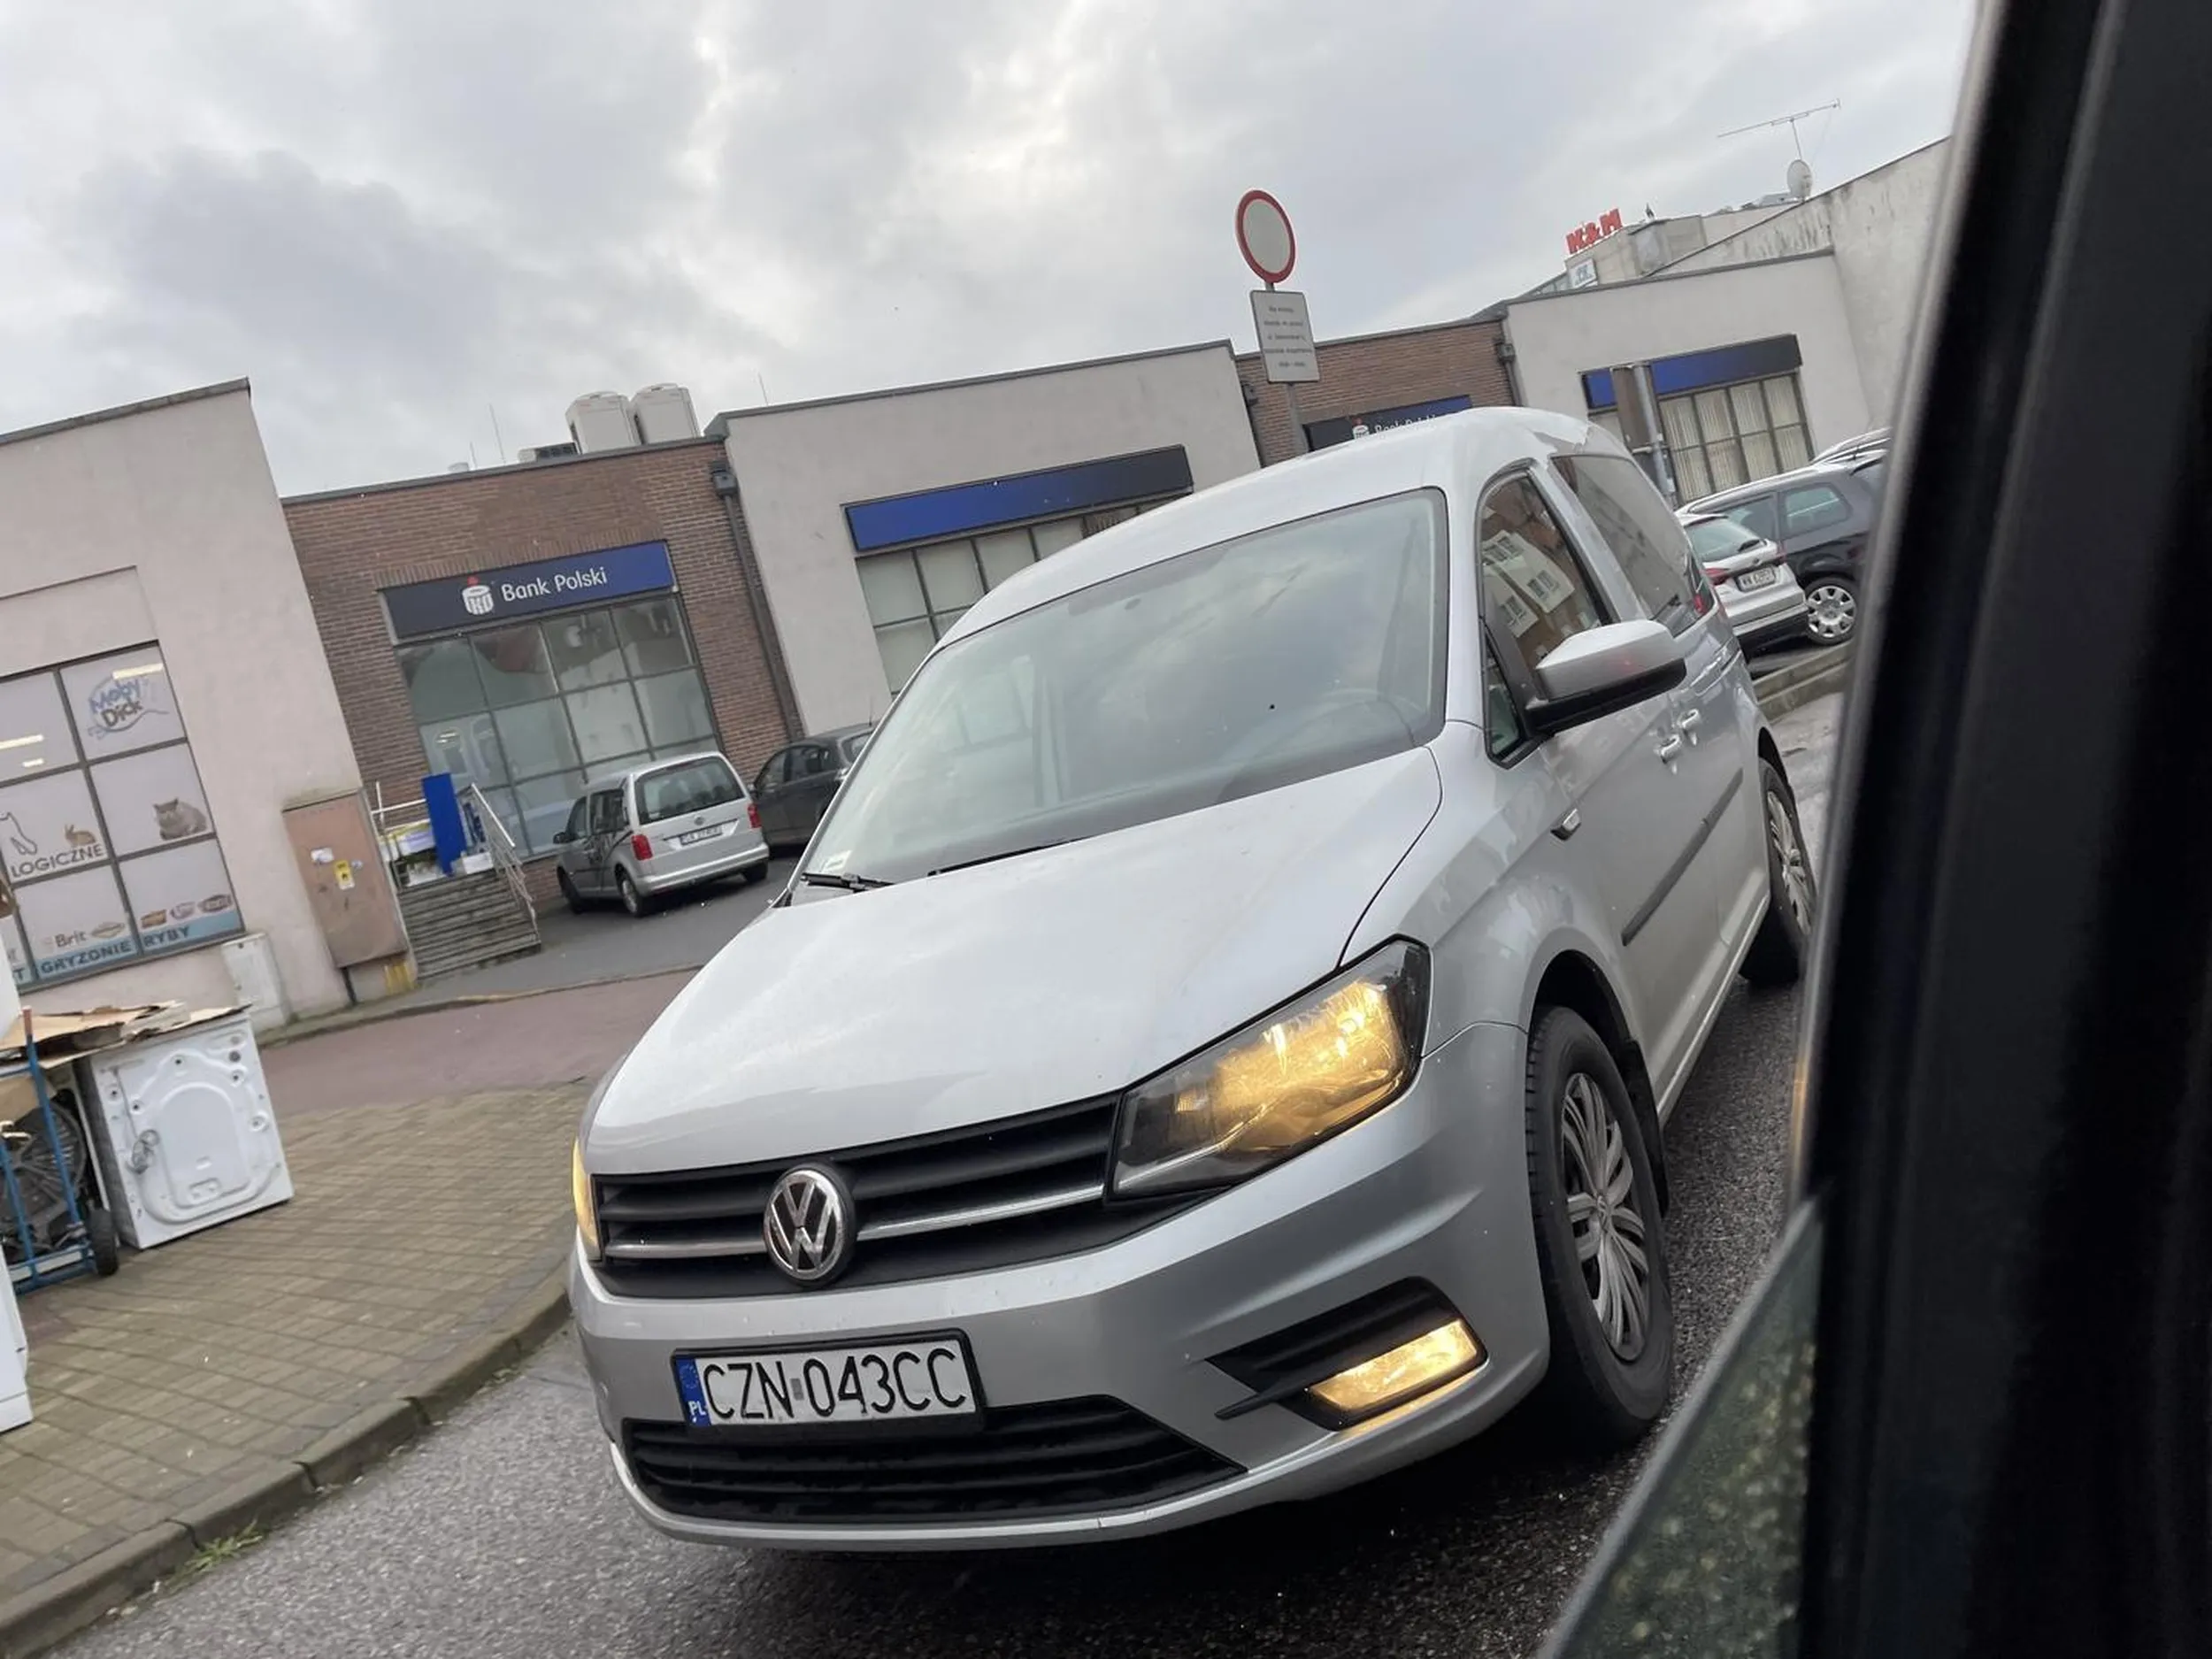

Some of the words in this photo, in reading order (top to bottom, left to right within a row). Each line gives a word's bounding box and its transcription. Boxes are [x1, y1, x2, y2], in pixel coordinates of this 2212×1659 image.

[501, 578, 551, 602] Bank
[554, 566, 608, 592] Polski
[88, 679, 141, 714] Moby
[101, 701, 143, 726] Dick
[11, 844, 104, 878] LOGICZNE
[41, 940, 131, 974] GRYZONIE
[142, 926, 189, 948] RYBY
[55, 930, 87, 948] Brit
[703, 1361, 795, 1419] CZN
[803, 1348, 966, 1417] 043CC
[688, 1401, 706, 1416] PL
